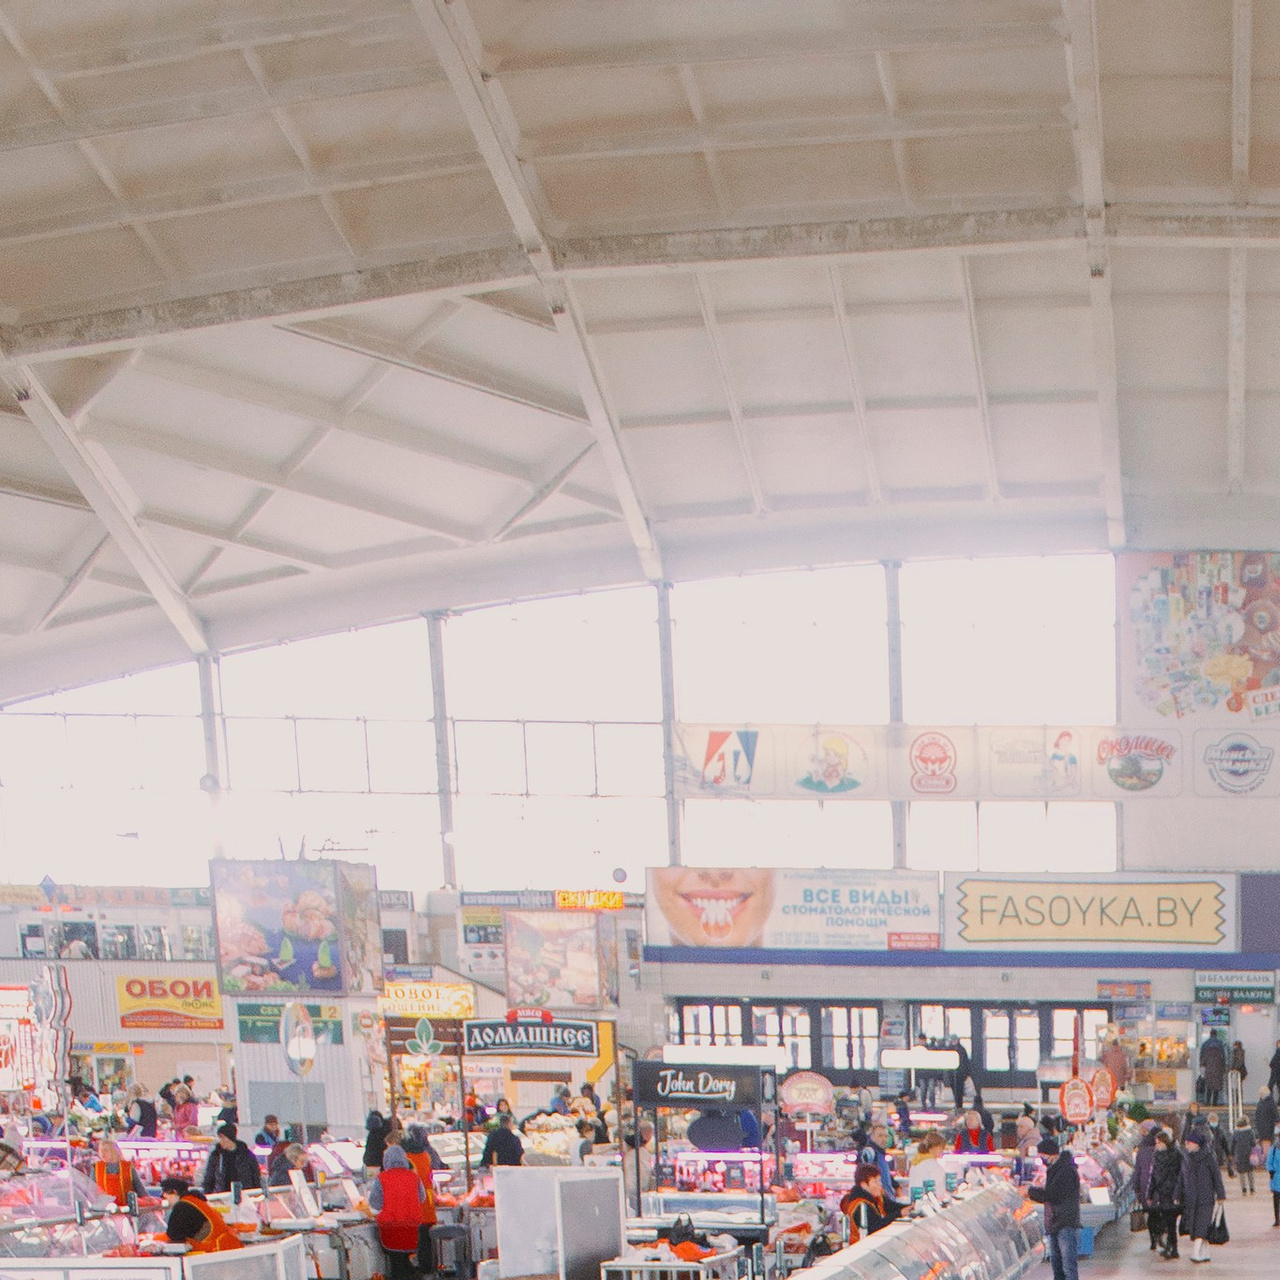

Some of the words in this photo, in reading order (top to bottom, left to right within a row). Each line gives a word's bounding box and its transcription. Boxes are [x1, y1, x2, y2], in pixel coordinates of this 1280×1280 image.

[802, 888, 841, 904] ВСЕ
[848, 889, 909, 905] ВИДЫ
[781, 904, 931, 917] СТОМАТОЛОГИЧЕСКОЙ
[978, 895, 1203, 928] FASOYKA.BY
[825, 916, 888, 928] ПОМОЩИ
[125, 979, 213, 999] ОБОИ
[327, 1006, 338, 1019] 2
[470, 1026, 591, 1049] ДОМАШНЕЕ
[657, 1069, 695, 1097] John
[698, 1071, 737, 1101] Dory
